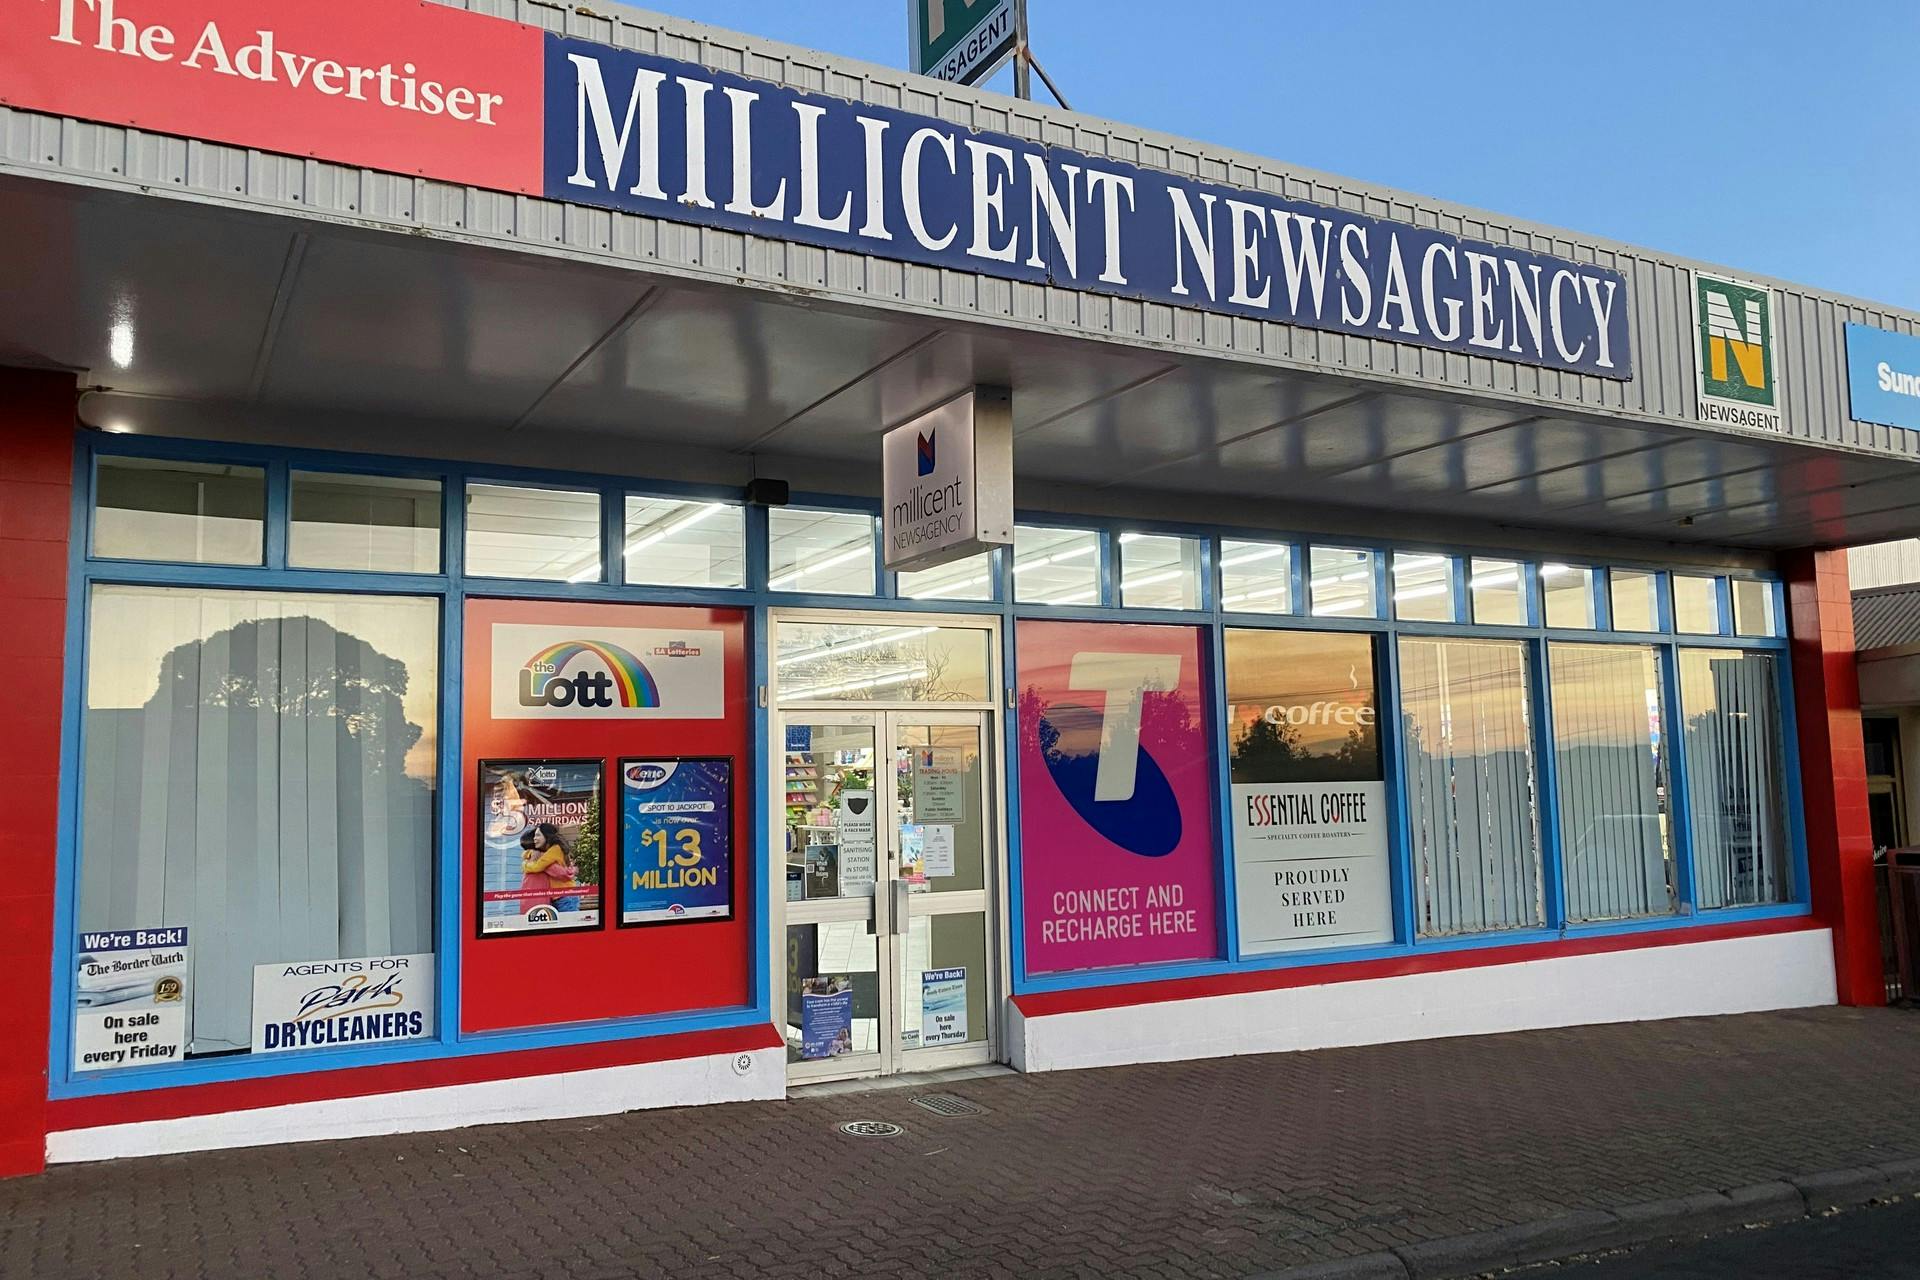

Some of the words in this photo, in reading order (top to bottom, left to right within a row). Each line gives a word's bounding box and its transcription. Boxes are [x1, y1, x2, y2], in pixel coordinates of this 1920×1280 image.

[42, 0, 175, 63] The
[181, 20, 503, 127] Advertiser
[566, 52, 1136, 287] MILLICENT
[1166, 186, 1618, 369] NEWSAGENCY
[1700, 402, 1780, 432] NEWSAGENT
[893, 474, 962, 529] millicent
[893, 512, 963, 552] NEWSAGENCY
[667, 648, 700, 656] Lotteries
[533, 661, 555, 673] the
[518, 670, 613, 708] Lott
[1265, 701, 1376, 725] coffee
[528, 802, 588, 815] MILLION
[1247, 794, 1317, 826] ESSENTIAL
[1320, 792, 1367, 824] COFFEE
[641, 828, 702, 868] $1.3
[1274, 868, 1350, 886] PROUDLY
[1053, 887, 1139, 915] CONNECT
[1146, 884, 1184, 908] AND
[1281, 889, 1345, 907] SERVED
[1042, 914, 1143, 944] RECHARGE
[1150, 910, 1197, 933] HERE
[1293, 910, 1337, 928] HERE
[85, 933, 131, 949] We're
[136, 929, 182, 946] Back!
[87, 963, 110, 976] The
[111, 958, 150, 973] Border
[151, 952, 184, 966] Watch
[283, 962, 362, 976] AGENTS
[370, 958, 409, 970] FOR
[924, 971, 943, 981] We're
[944, 970, 963, 979] Back!
[159, 983, 177, 994] 159
[104, 1015, 123, 1029] On
[128, 1013, 160, 1027] sale
[264, 1010, 423, 1049] DRYCLEANERS
[114, 1031, 148, 1044] here
[925, 1033, 940, 1041] every
[941, 1030, 966, 1039] Thursday
[83, 1050, 125, 1063] every
[130, 1044, 177, 1059] Friday
